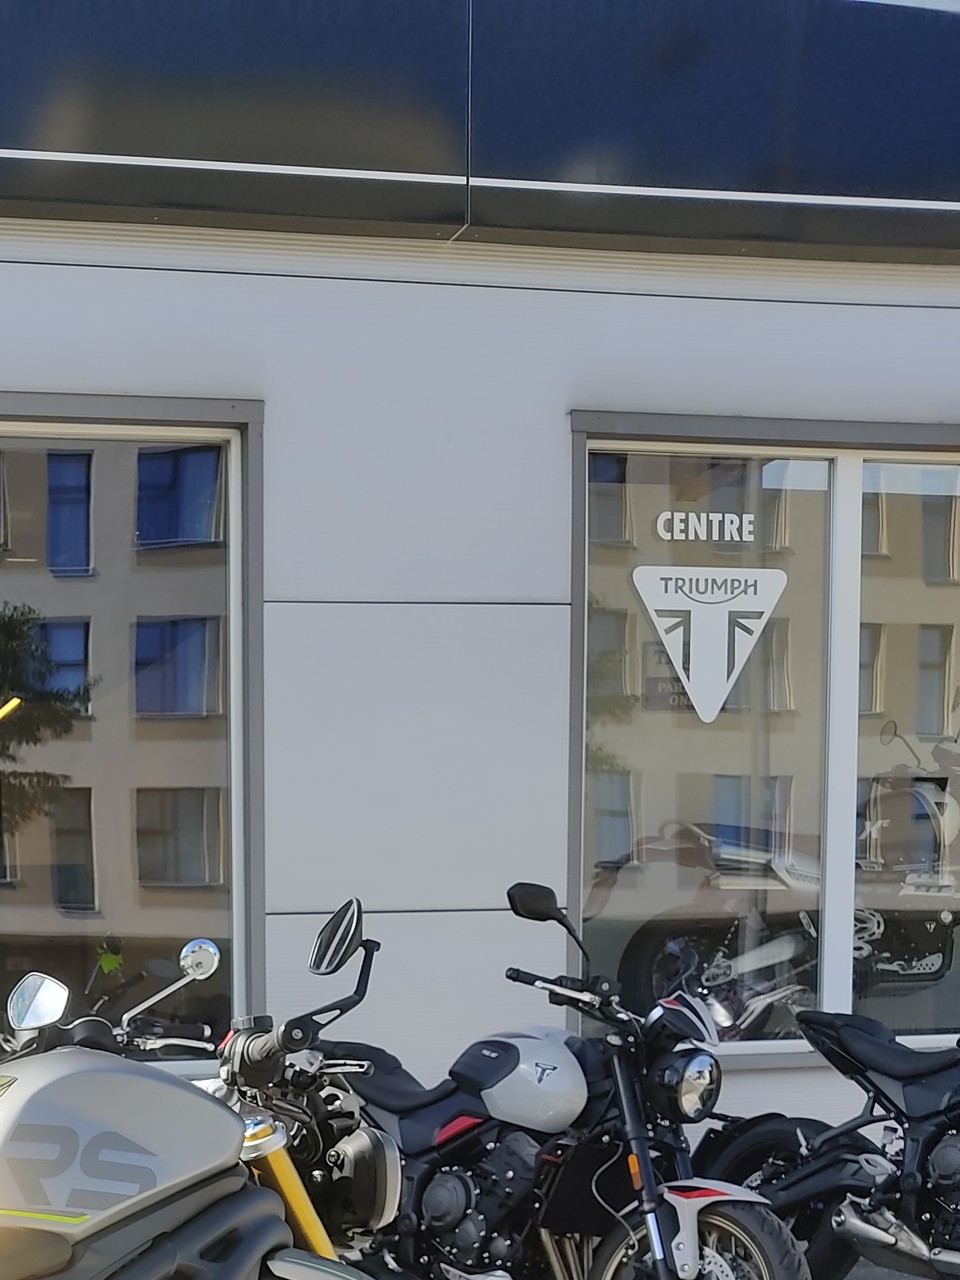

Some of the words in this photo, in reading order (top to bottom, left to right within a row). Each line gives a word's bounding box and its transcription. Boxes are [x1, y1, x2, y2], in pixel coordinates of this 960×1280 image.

[656, 511, 755, 542] CENTRE
[659, 576, 759, 604] TRIUMPH
[4, 1123, 159, 1212] RS
